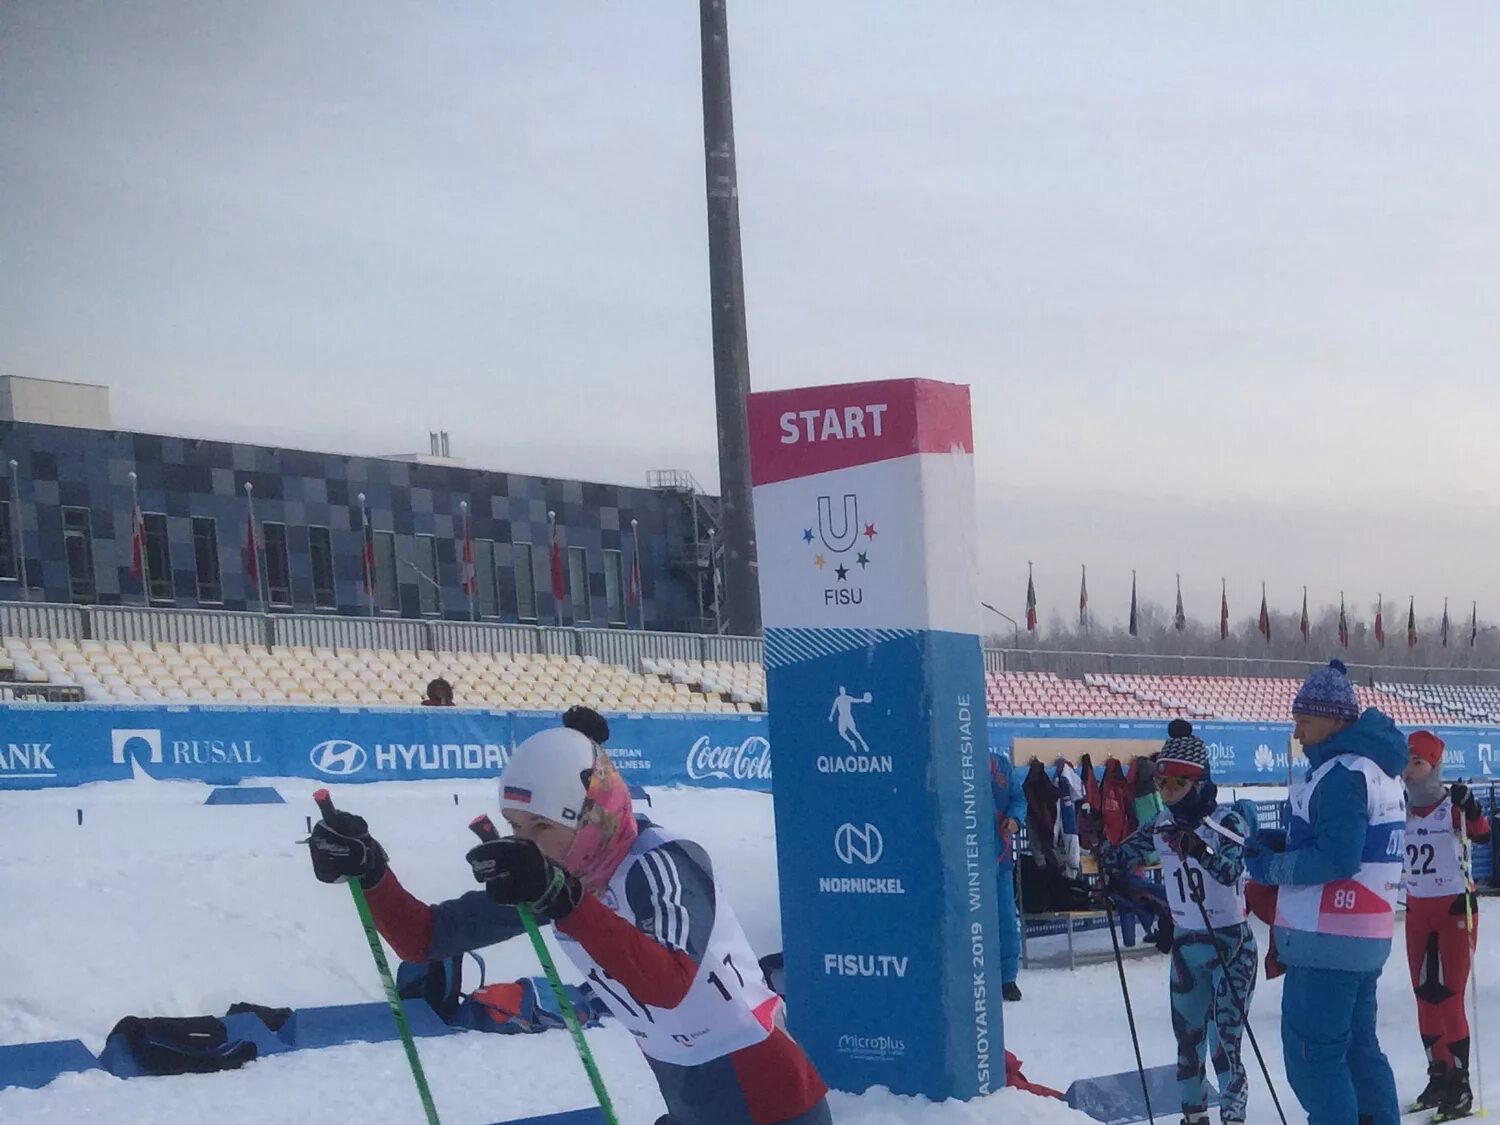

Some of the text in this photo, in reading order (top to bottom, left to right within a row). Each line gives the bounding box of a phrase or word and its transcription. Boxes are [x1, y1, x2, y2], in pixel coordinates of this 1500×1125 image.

[780, 404, 888, 444] START
[824, 588, 864, 605] FISU
[172, 740, 262, 764] RUSAL
[817, 755, 893, 773] QIAODAN
[956, 693, 978, 831] UNIVERSIADE
[963, 834, 983, 912] WINTER
[1173, 865, 1206, 904] 19
[819, 877, 905, 894] NORNICKEL
[1334, 889, 1357, 910] 89
[971, 921, 985, 966] 2019
[824, 954, 909, 978] FISU.TV
